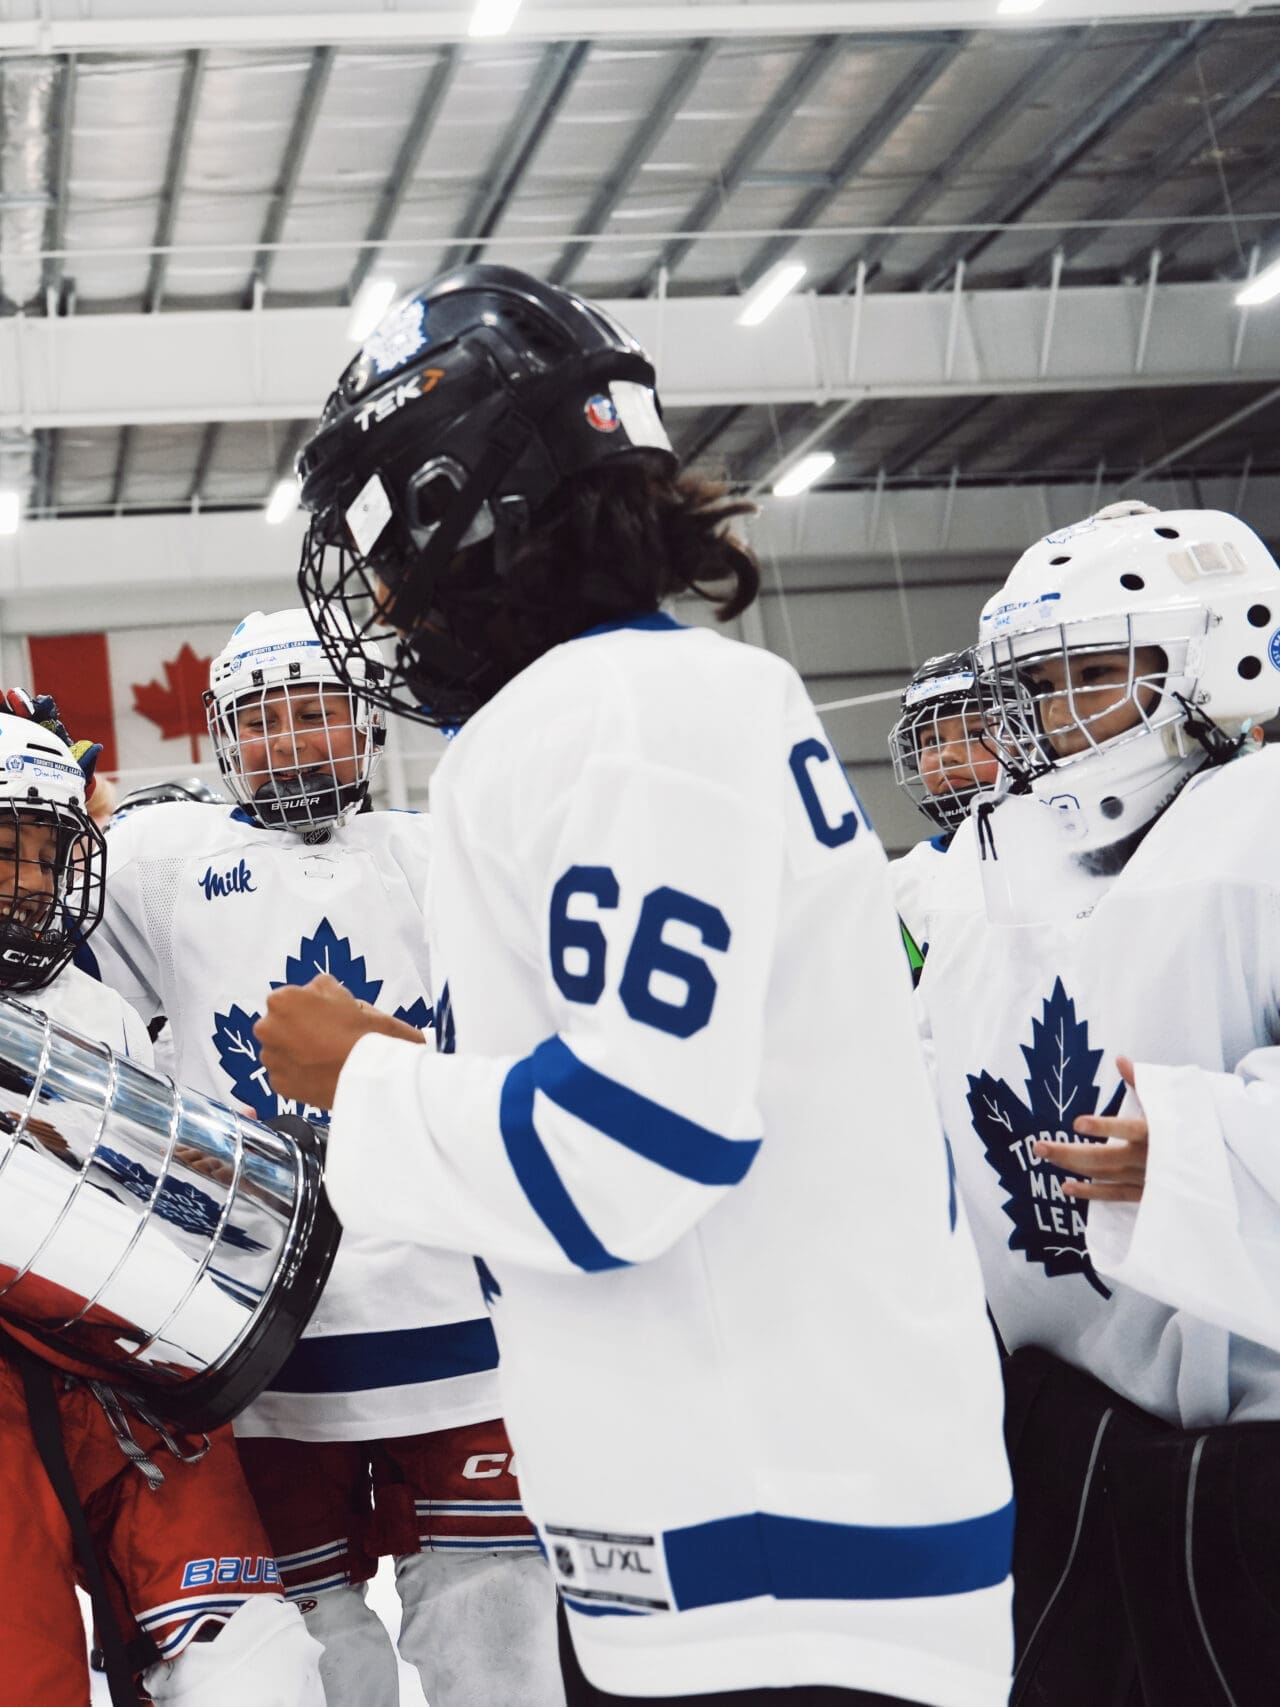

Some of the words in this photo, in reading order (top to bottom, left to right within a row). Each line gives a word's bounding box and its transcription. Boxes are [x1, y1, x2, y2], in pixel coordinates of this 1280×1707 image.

[248, 647, 271, 656] TORONTO
[34, 757, 54, 768] TORONTO
[54, 762, 69, 772] MAPLE
[198, 858, 257, 901] Milk
[2, 949, 55, 968] CCM
[550, 865, 732, 1040] 66
[1034, 1203, 1088, 1236] LEA
[181, 1556, 283, 1590] BAUE
